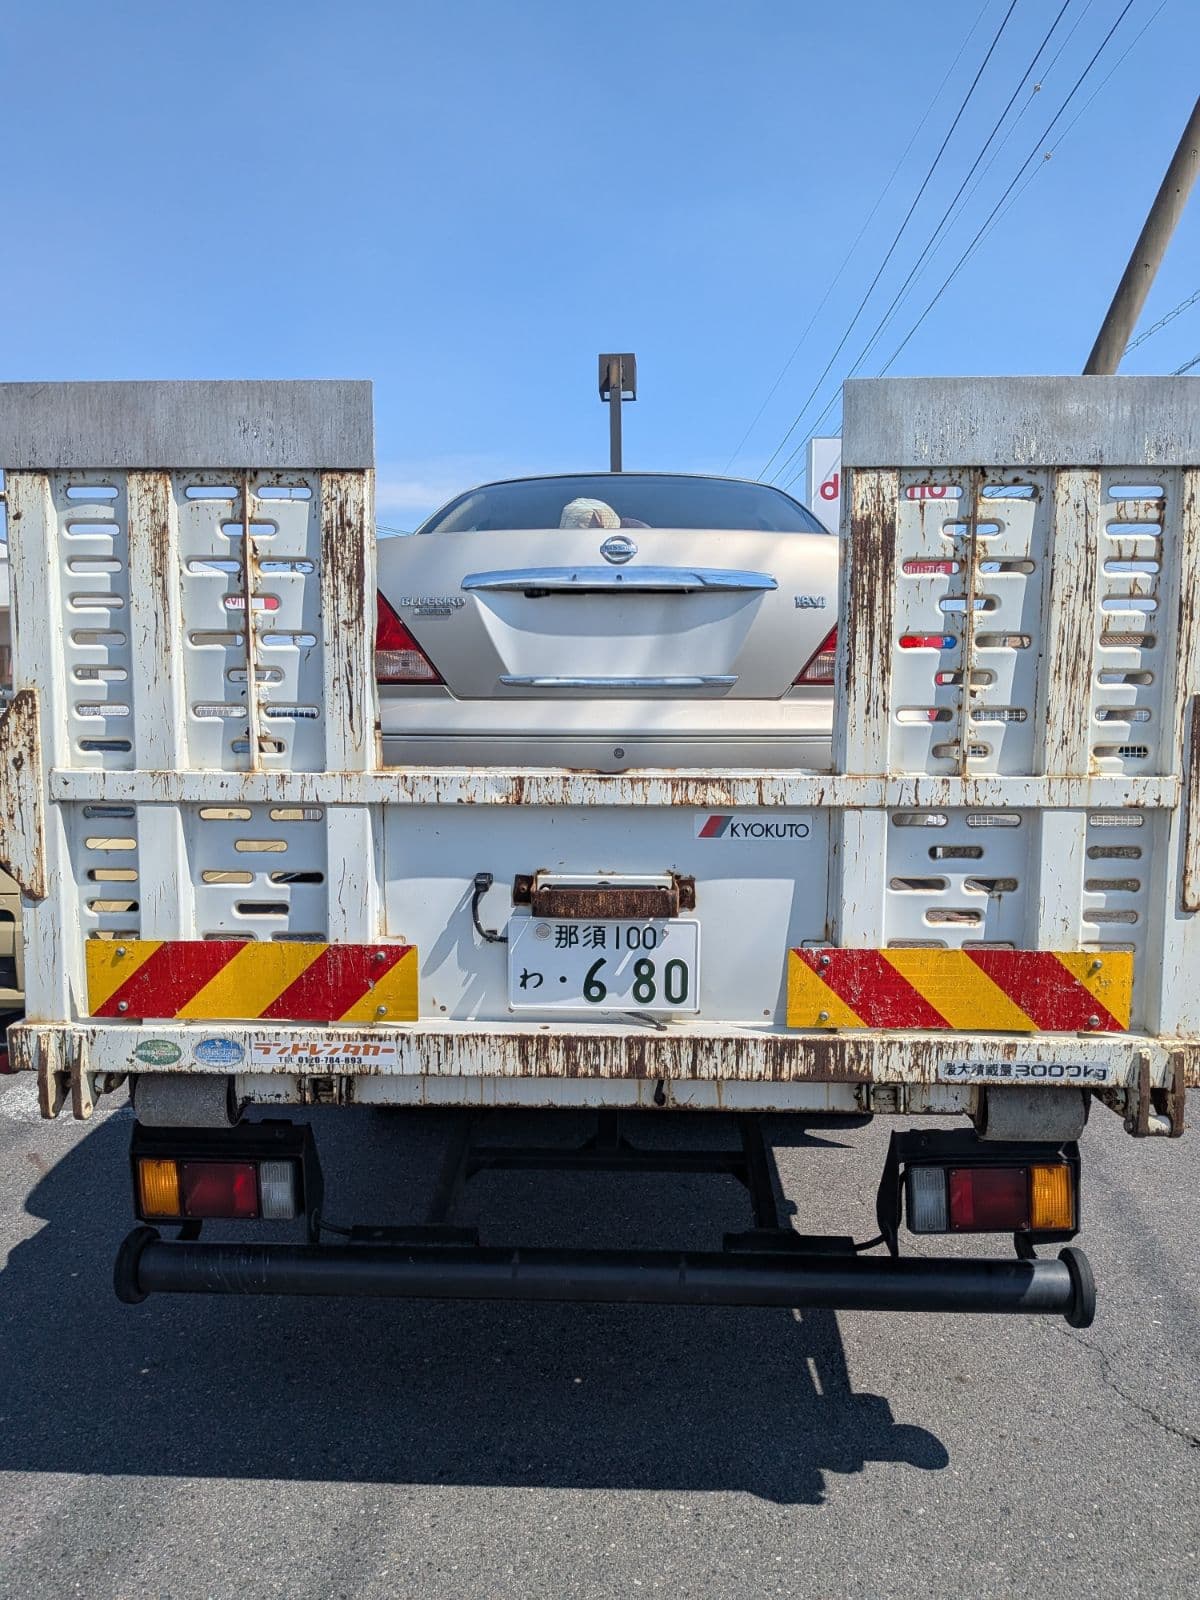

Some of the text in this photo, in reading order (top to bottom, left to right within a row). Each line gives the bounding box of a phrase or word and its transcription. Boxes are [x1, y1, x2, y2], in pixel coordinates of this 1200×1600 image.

[401, 596, 466, 607] BLUEBIRD
[730, 823, 810, 838] KYOKUTO
[254, 1043, 395, 1056] ランドレンタカー
